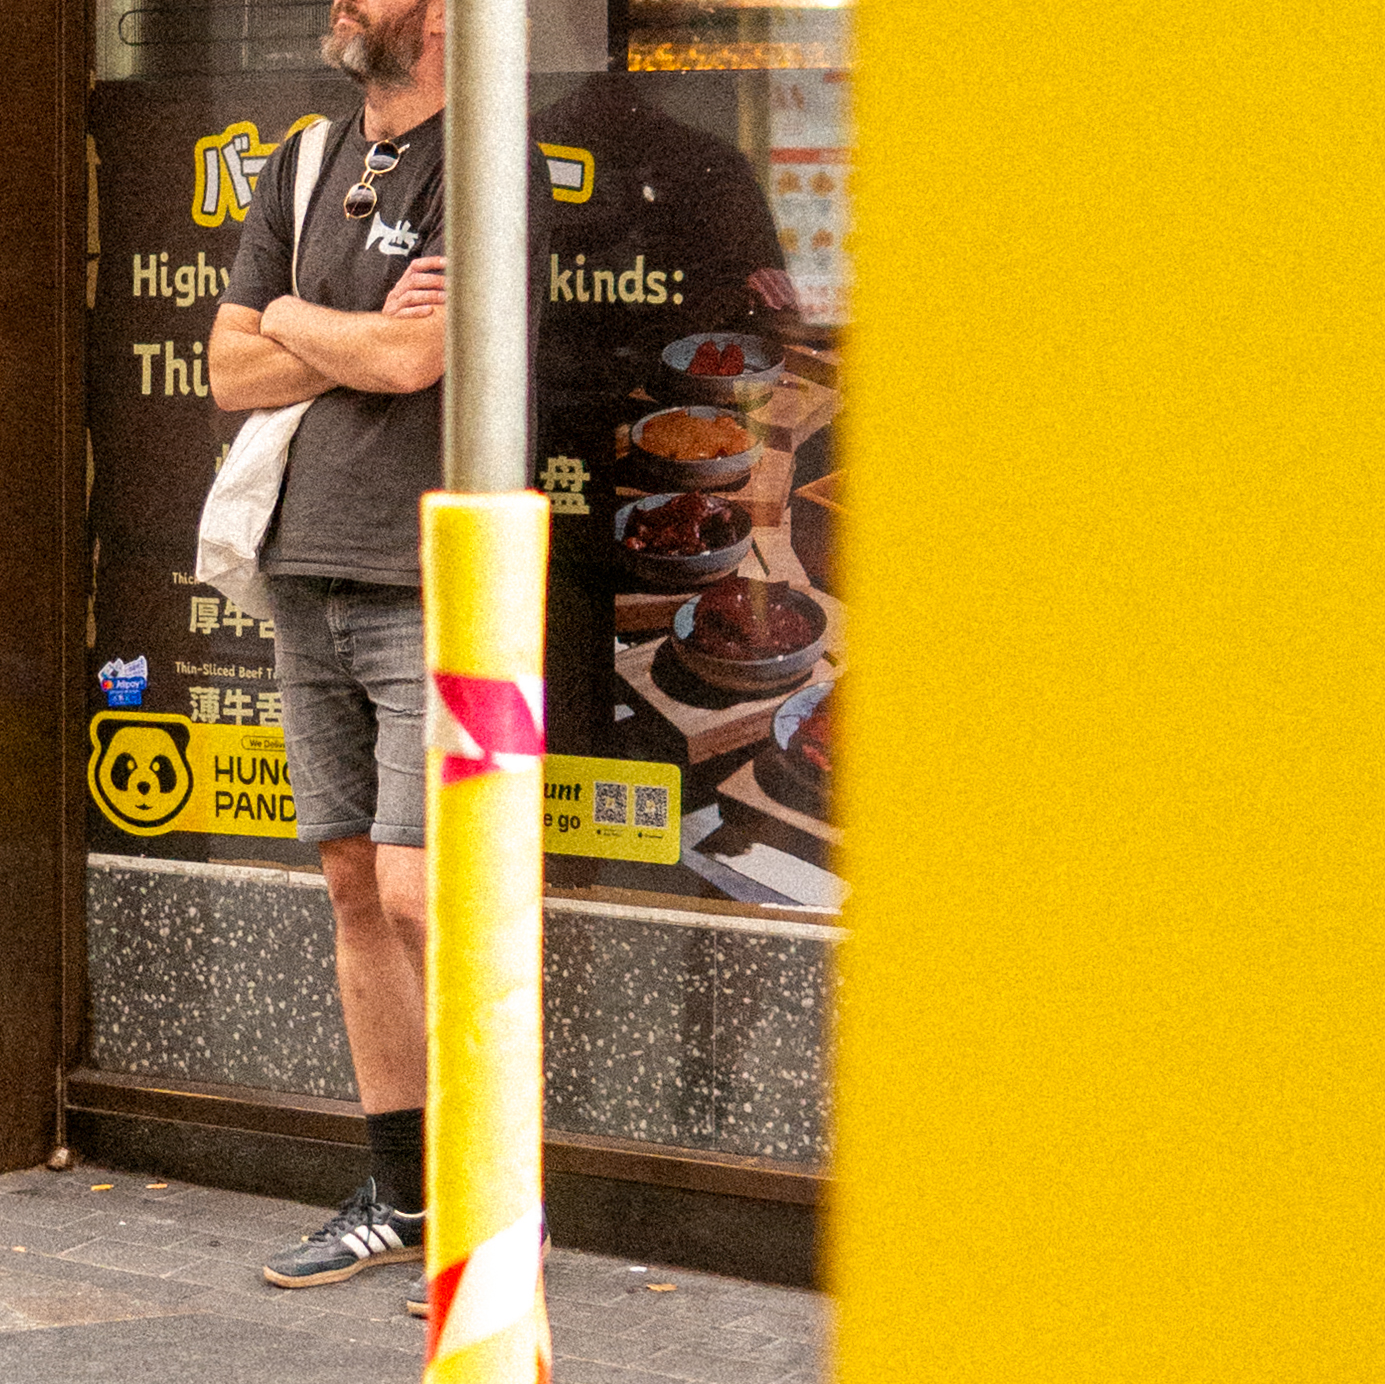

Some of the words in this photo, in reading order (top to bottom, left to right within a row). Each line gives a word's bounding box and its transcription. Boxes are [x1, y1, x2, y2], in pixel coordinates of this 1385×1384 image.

[550, 253, 684, 305] kinds:
[133, 340, 209, 397] Thi
[189, 595, 275, 638] 厚牛
[175, 661, 235, 677] Thin-Sliced
[238, 666, 263, 679] Beef
[215, 790, 297, 822] PAND
[557, 814, 581, 833] go
